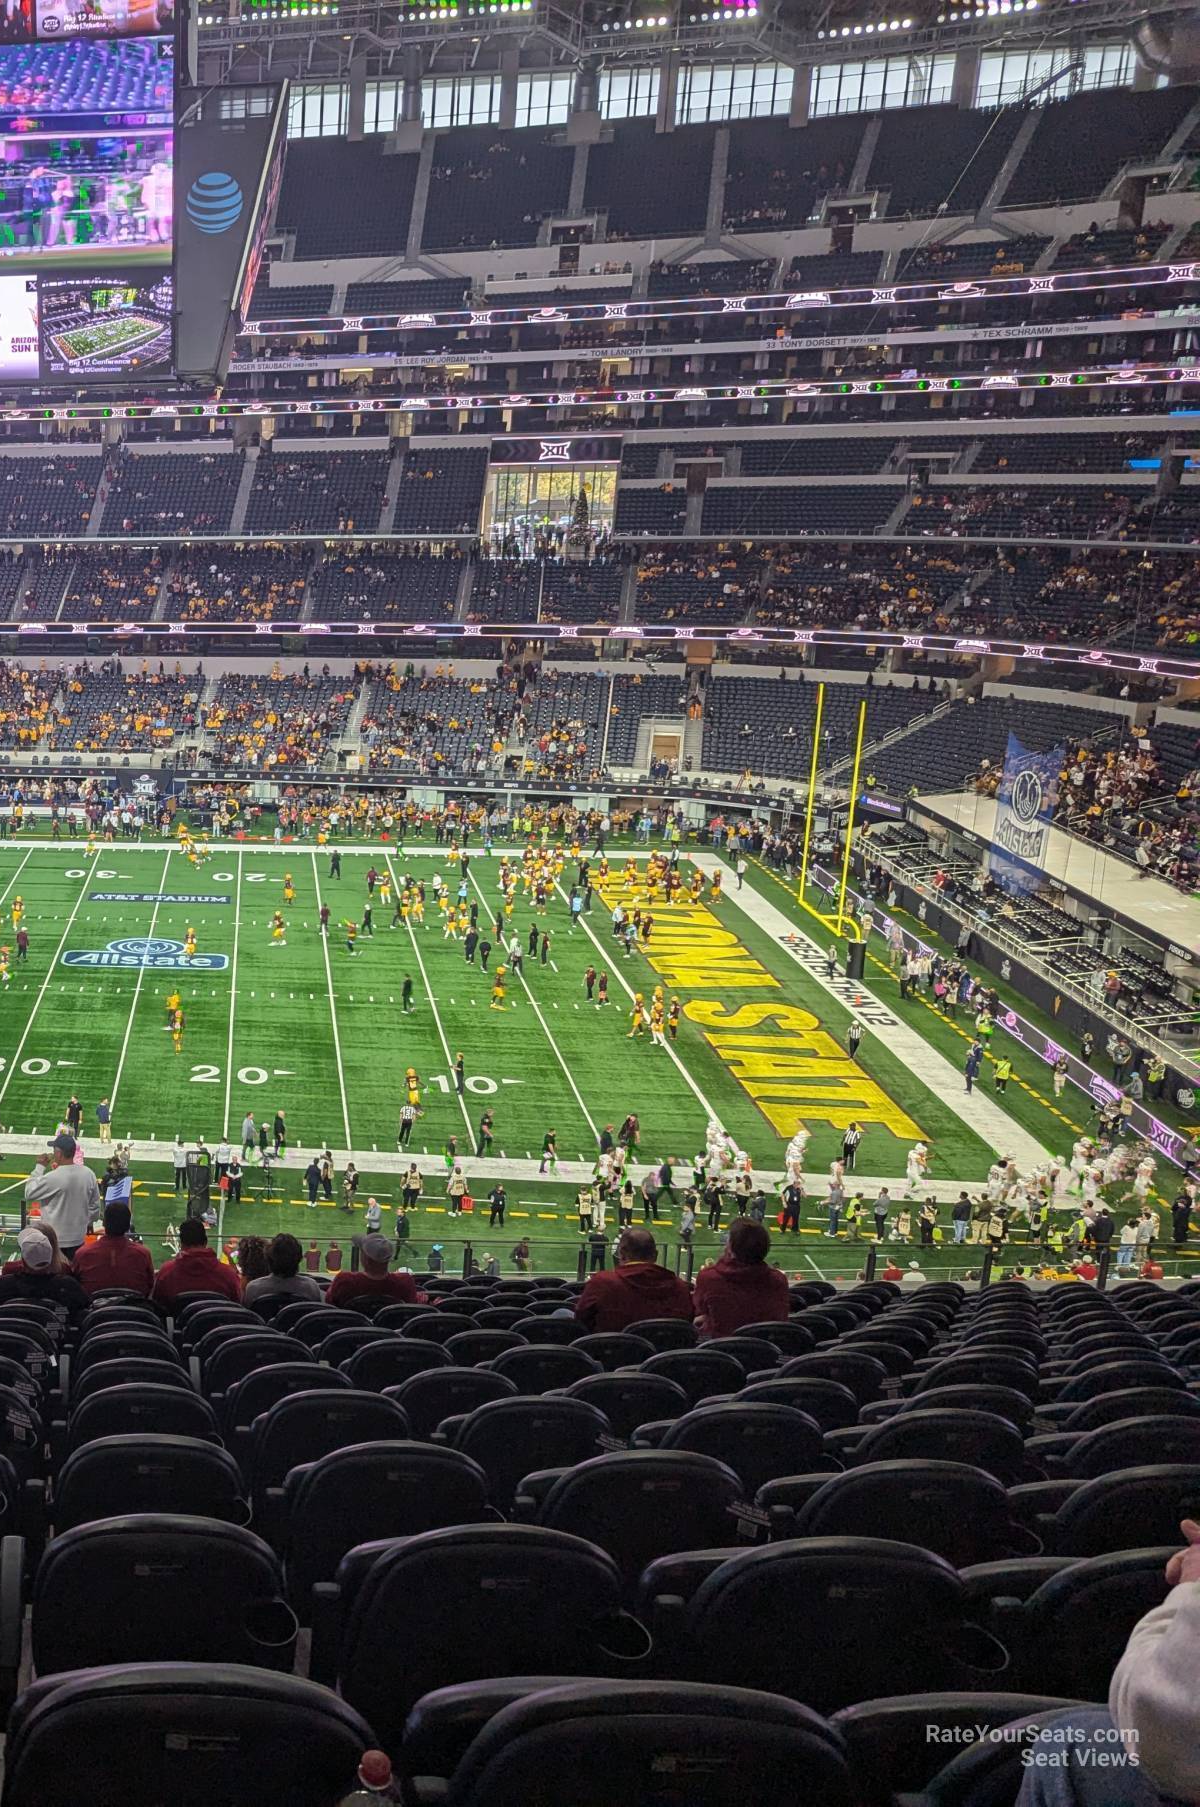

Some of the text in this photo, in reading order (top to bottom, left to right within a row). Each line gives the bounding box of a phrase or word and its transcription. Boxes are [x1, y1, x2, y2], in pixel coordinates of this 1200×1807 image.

[983, 328, 1001, 338] TEX
[1004, 327, 1053, 338] SCHRAMM
[780, 340, 802, 348] TONY
[806, 337, 848, 347] DORSETT
[11, 345, 31, 353] SUN
[610, 348, 643, 356] LANDRY
[91, 358, 132, 367] Conference
[406, 357, 419, 365] LEE
[437, 355, 466, 363] JORDAN
[232, 363, 256, 371] ROGER
[539, 441, 571, 460] XII
[64, 869, 120, 880] 30
[212, 872, 267, 883] 20
[91, 893, 227, 903] AT&T STADIUM
[1168, 943, 1184, 958] FORKS
[73, 952, 212, 966] Allstate
[825, 978, 882, 1010] THAN
[856, 1011, 899, 1027] 12
[189, 1064, 269, 1086] 20
[681, 998, 936, 1144] STATE
[428, 1073, 499, 1094] 10
